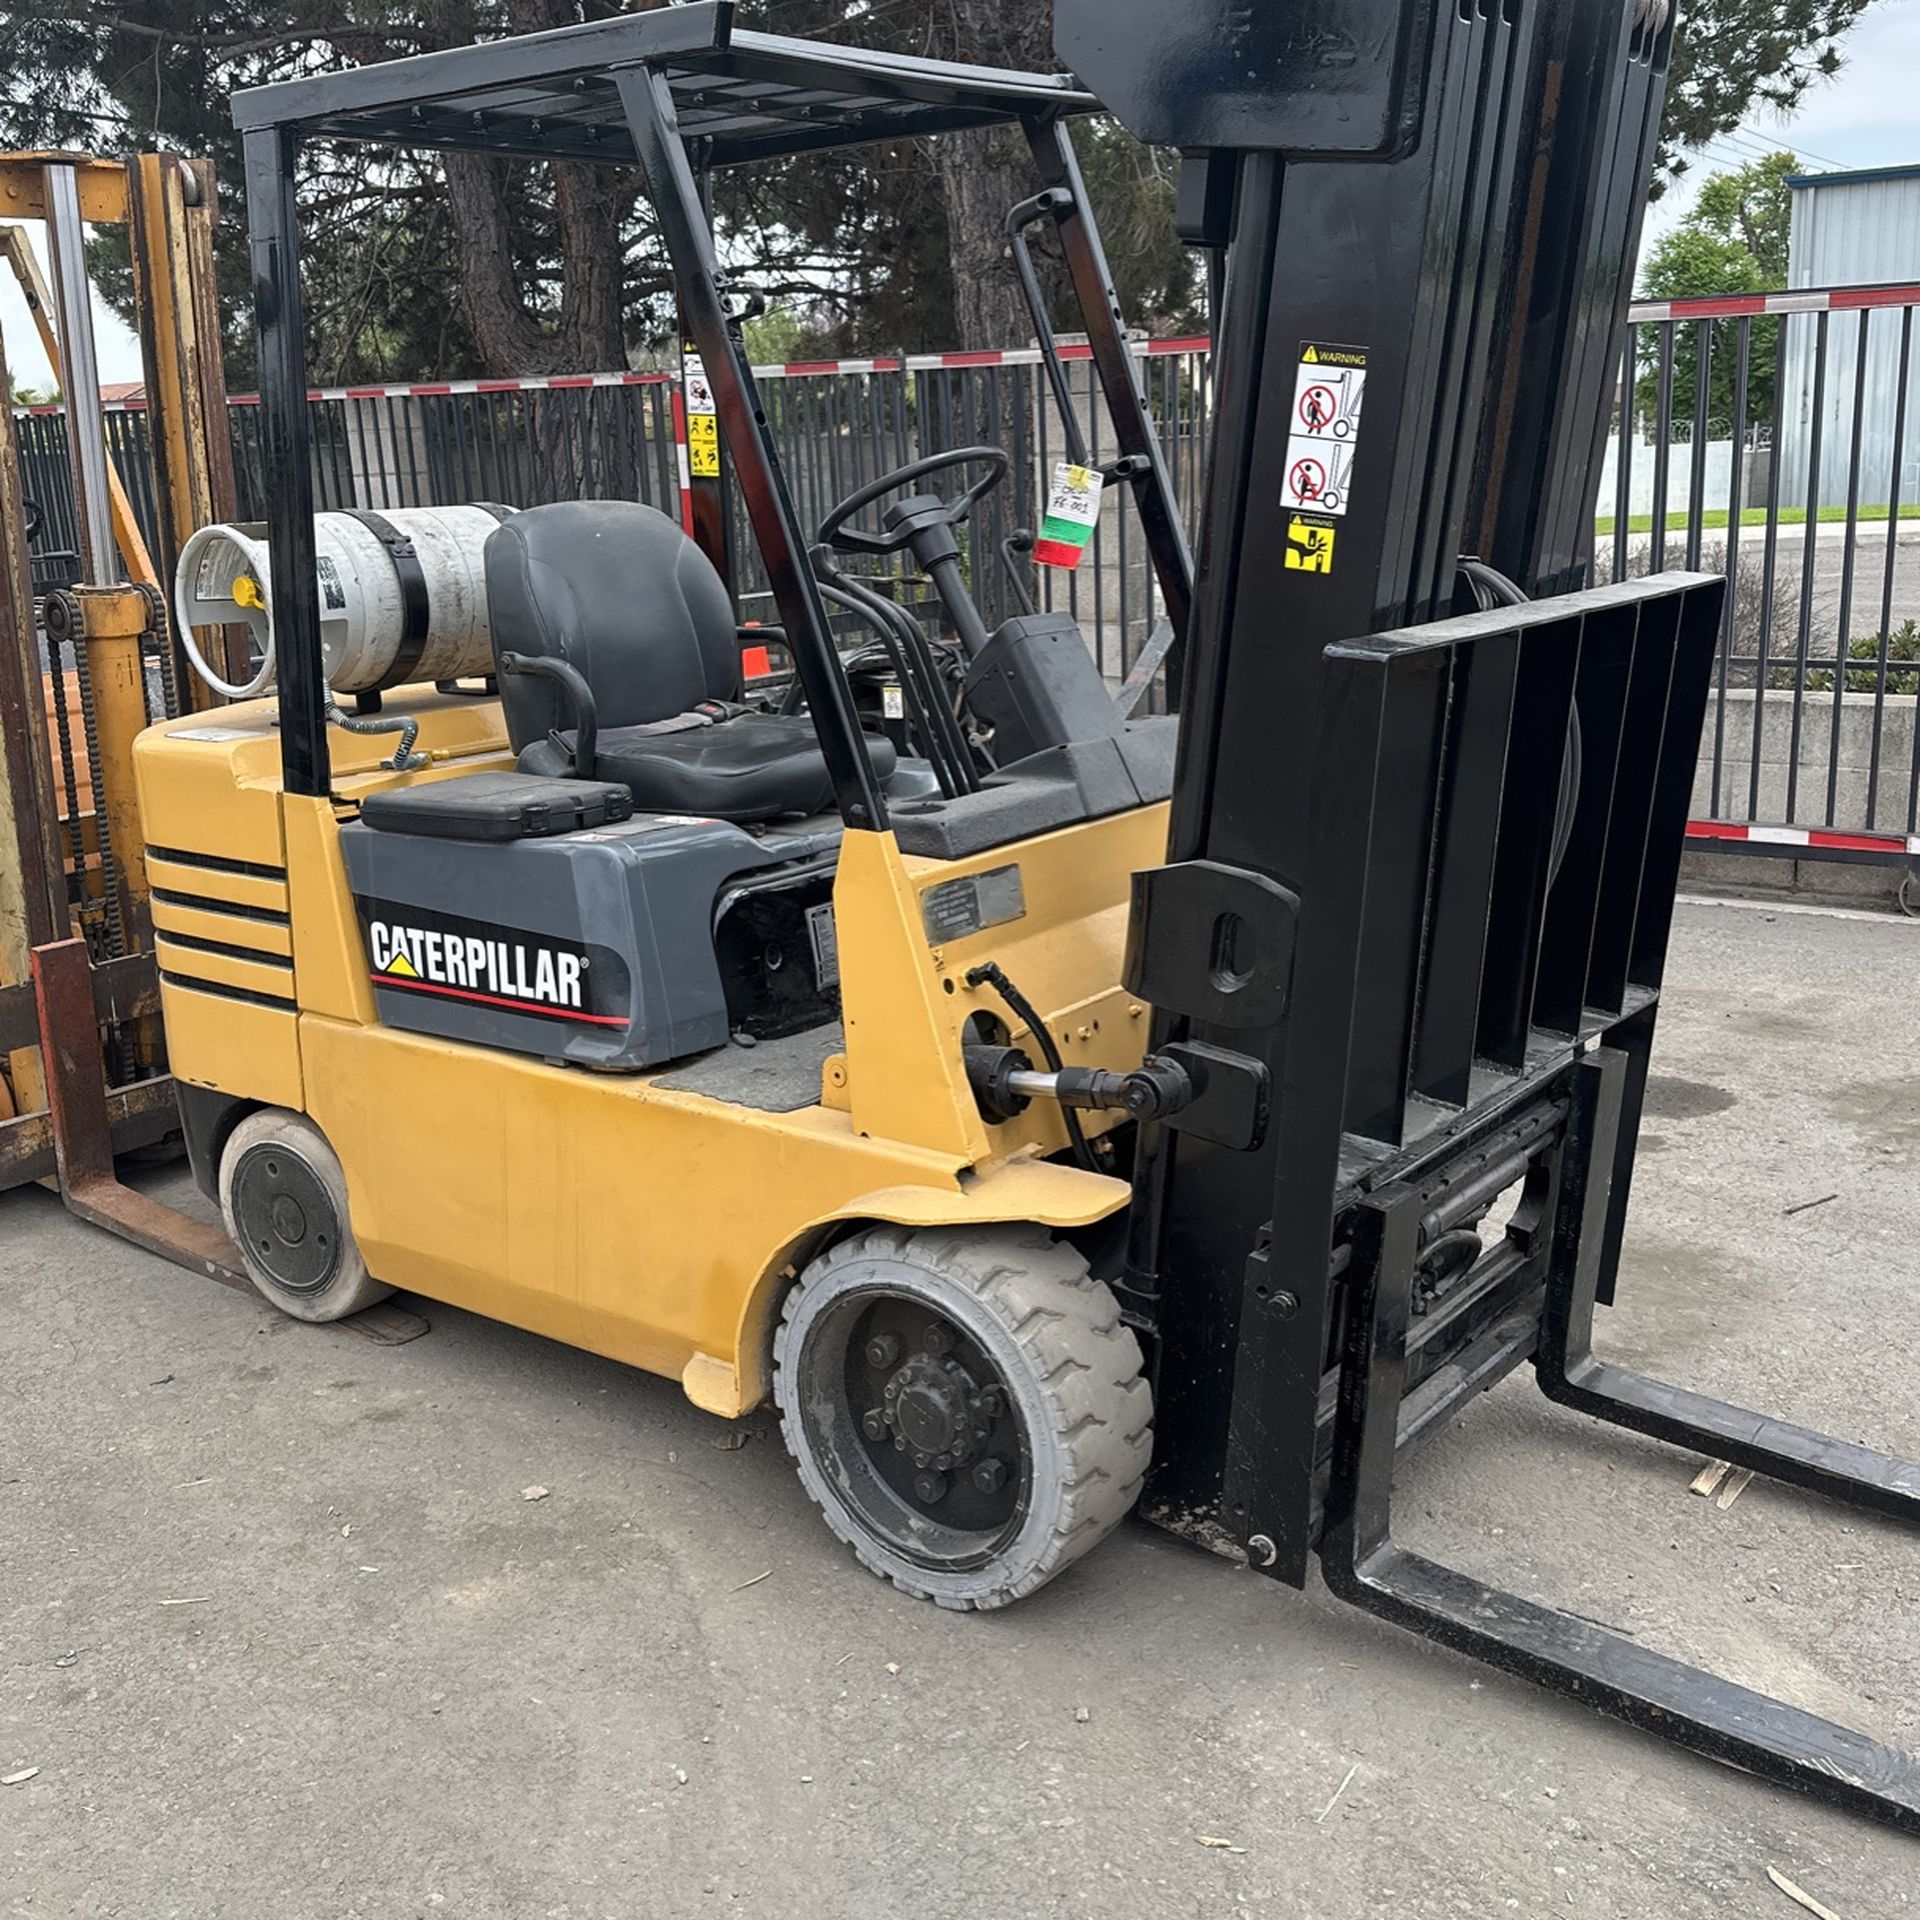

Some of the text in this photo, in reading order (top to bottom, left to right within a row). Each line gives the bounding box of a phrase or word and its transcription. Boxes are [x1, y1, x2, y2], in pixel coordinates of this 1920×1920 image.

[1319, 351, 1366, 366] WARNING
[1303, 518, 1334, 527] WARNING
[370, 921, 582, 1008] CATERPILLAR
